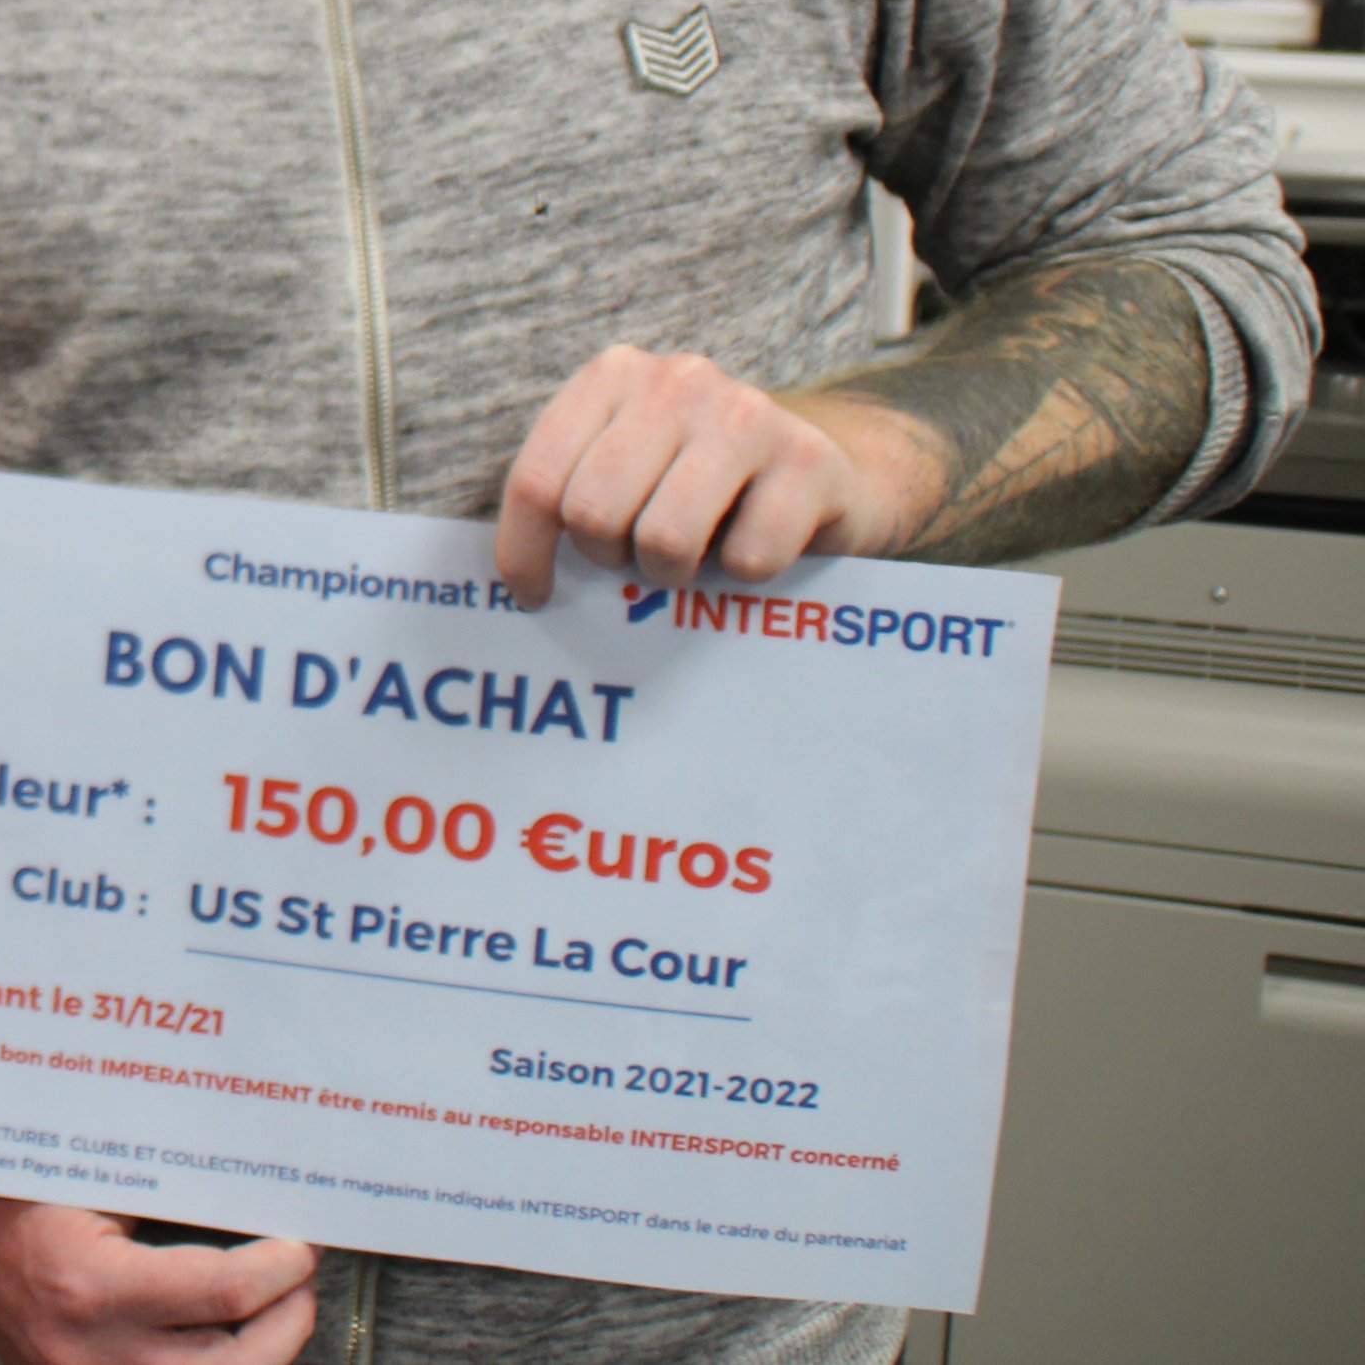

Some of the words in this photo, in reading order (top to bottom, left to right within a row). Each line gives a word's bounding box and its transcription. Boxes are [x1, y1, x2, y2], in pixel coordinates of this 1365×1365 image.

[202, 549, 480, 611] Championnat
[488, 578, 532, 614] R
[673, 588, 1006, 658] INTERSPORT
[103, 628, 266, 704] BON
[290, 649, 637, 745] D'ACHAT
[222, 771, 496, 863] 150,00
[519, 810, 773, 895] €uros
[10, 864, 127, 915] Club
[188, 881, 264, 932] US
[275, 893, 335, 942] St
[348, 902, 518, 965] Pierre
[531, 924, 596, 975] La
[609, 935, 749, 990] Cour
[50, 983, 83, 1018] le
[91, 990, 224, 1037] 31/12/21
[47, 1050, 94, 1074] doit
[98, 1056, 313, 1104] IMPERATIVEMENT
[316, 1086, 365, 1113] être
[370, 1098, 438, 1123] remis
[441, 1107, 473, 1128] au
[477, 1112, 625, 1146] responsable
[629, 1127, 786, 1162] INTERSPORT
[788, 1147, 901, 1173] concerné
[488, 1046, 616, 1091] Saison
[623, 1062, 821, 1112] 2021-2022
[20, 1154, 64, 1180] Pays
[64, 1162, 91, 1183] de
[92, 1165, 111, 1185] la
[113, 1170, 160, 1193] Loire
[68, 1134, 131, 1160] CLUBS
[132, 1143, 158, 1164] ET
[159, 1147, 302, 1185] COLLECTIVITES
[303, 1169, 339, 1191] des
[340, 1176, 431, 1203] magasins
[433, 1189, 517, 1214] indiqués
[519, 1197, 644, 1227] INTERSPORT
[644, 1212, 693, 1235] dans
[694, 1216, 714, 1237] le
[715, 1221, 772, 1242] cadre
[772, 1225, 800, 1246] du
[803, 1230, 908, 1254] partenariat
